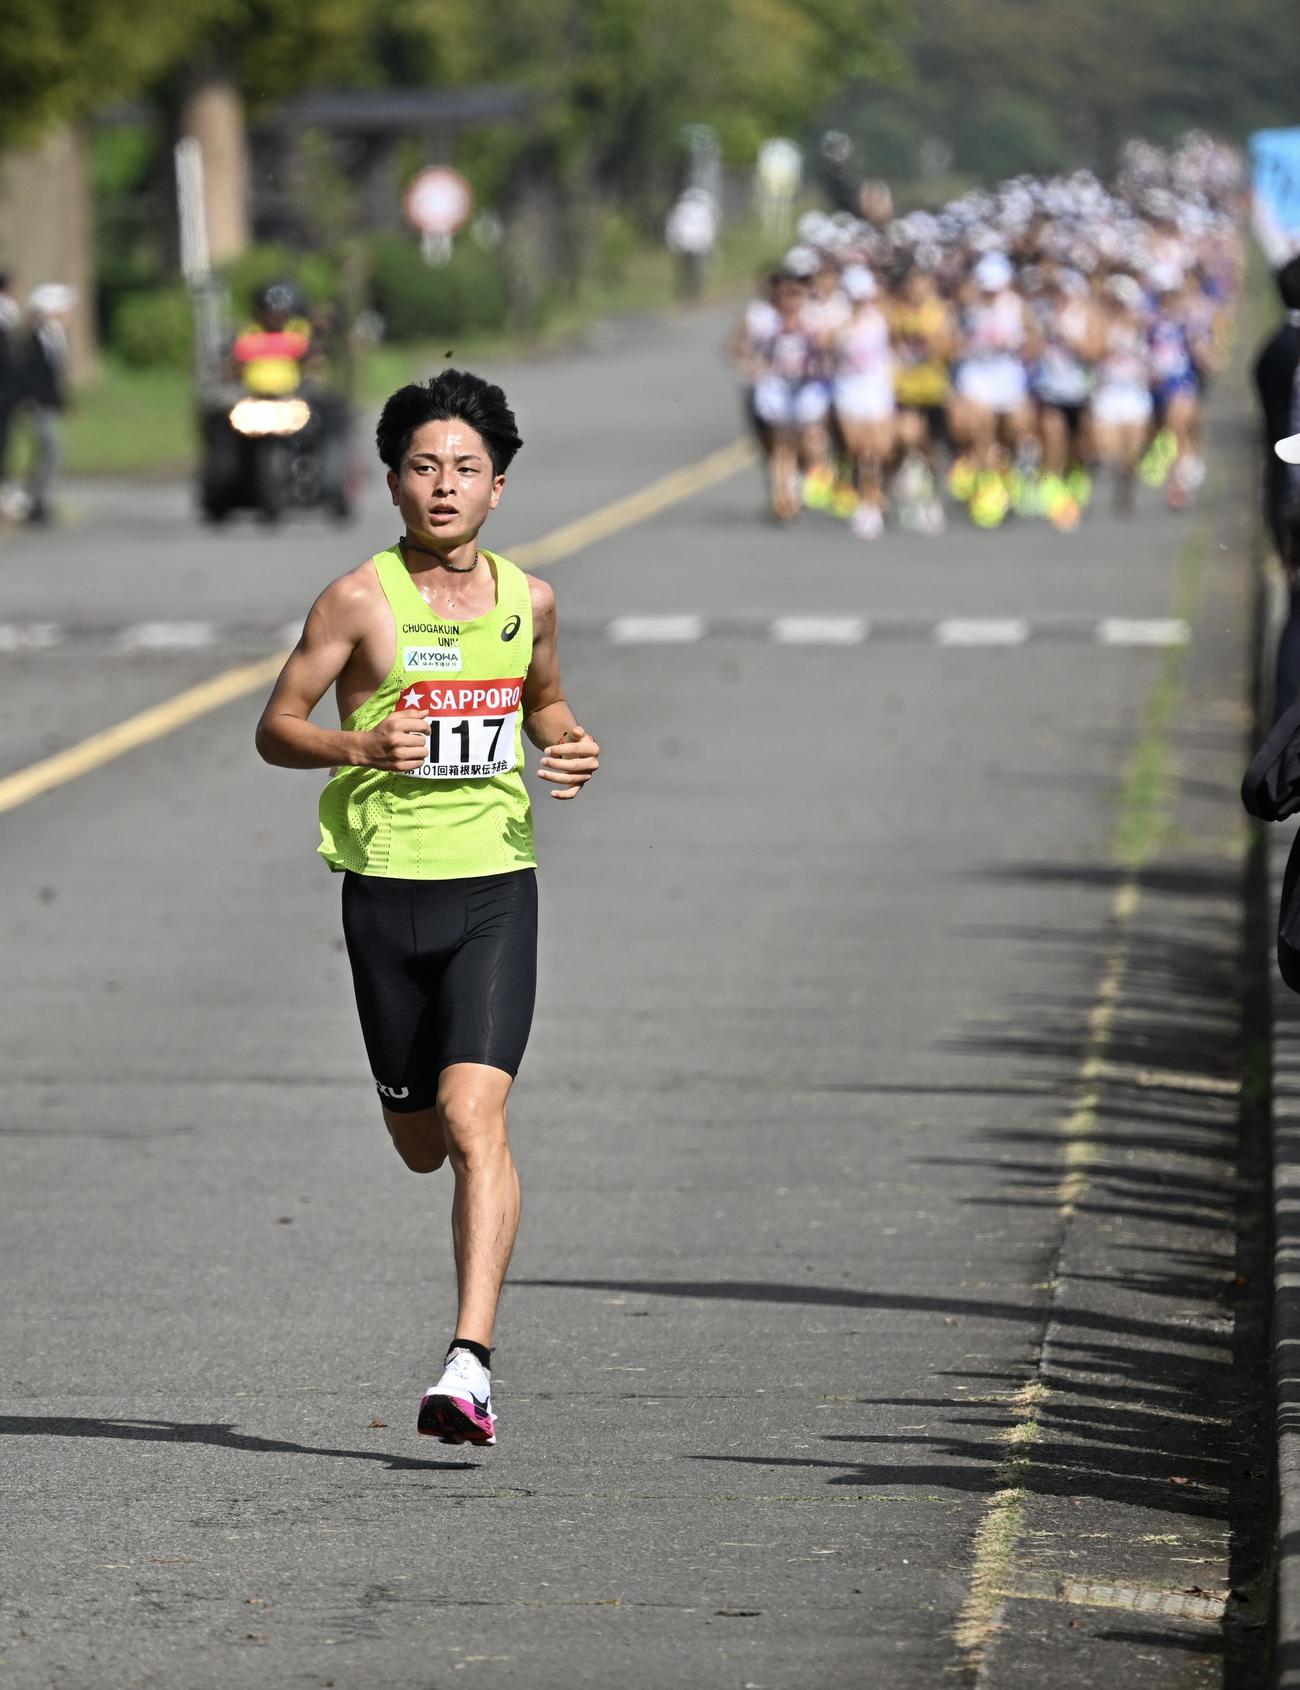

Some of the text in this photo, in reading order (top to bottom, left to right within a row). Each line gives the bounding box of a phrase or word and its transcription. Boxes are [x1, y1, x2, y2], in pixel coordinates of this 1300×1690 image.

[402, 623, 460, 635] CHUOGAKUIN
[420, 652, 459, 661] KYOWA
[430, 687, 520, 710] SAPPORO
[429, 717, 505, 763] 117
